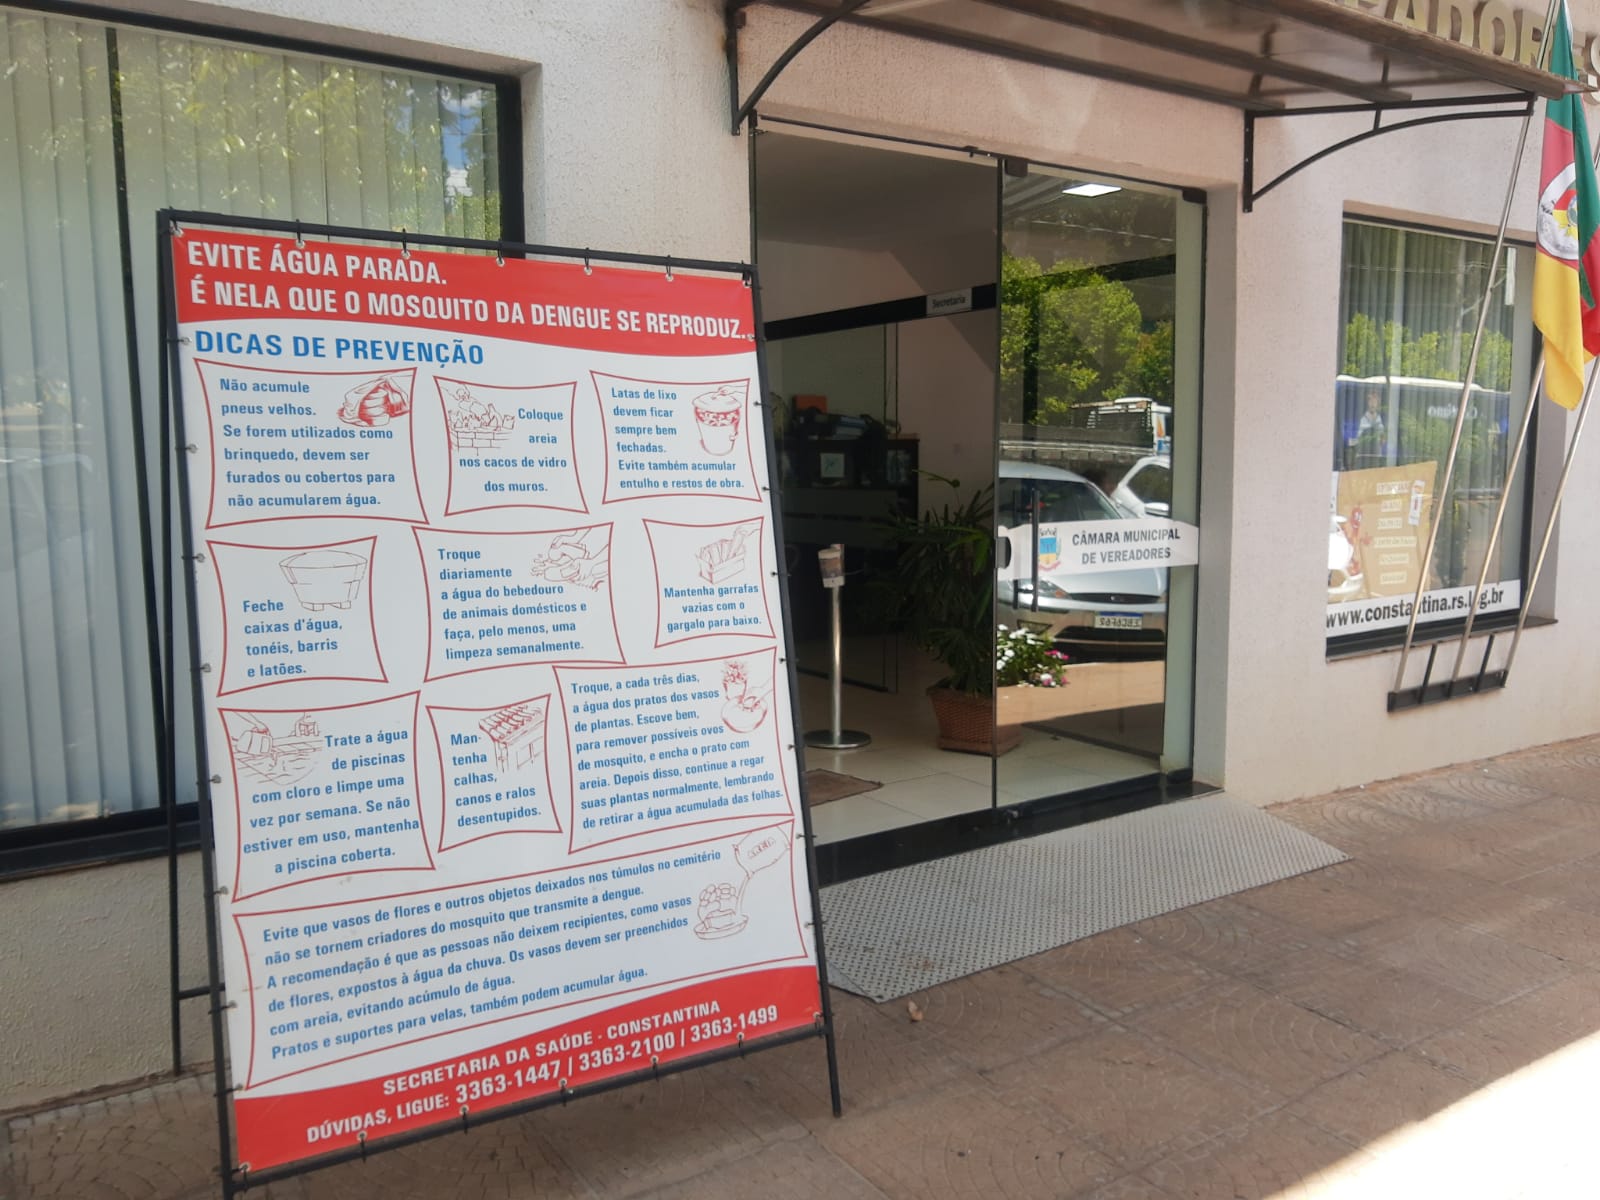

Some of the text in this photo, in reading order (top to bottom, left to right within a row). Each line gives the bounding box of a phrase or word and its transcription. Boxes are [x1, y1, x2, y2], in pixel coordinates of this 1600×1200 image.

[188, 241, 447, 285] EVITE ÁGUA PARADA.
[191, 274, 747, 340] É NELA QUE O MOSQUITO DA DENGUE SE REPRODUZ.
[195, 330, 484, 369] DICAS DE PREVENÇÃO
[220, 378, 310, 394] Não acumule
[611, 387, 677, 401] Latas de lixo
[221, 403, 317, 417] pneus velhos.
[518, 408, 564, 423] Coloque
[613, 405, 674, 418] devem ficar
[223, 424, 394, 439] Se forem utilizados como
[529, 433, 558, 444] areia
[614, 424, 677, 438] sempre bem
[616, 441, 667, 453] fechadas.
[224, 448, 370, 464] brinquedo, devem ser
[459, 456, 567, 468] nos cacos de vidro
[618, 459, 736, 471] Evite também acumular
[226, 471, 396, 486] furados ou cobertos para
[228, 493, 381, 508] não acumularem água.
[1072, 528, 1181, 546] CÂMARA MUNICIPAL
[437, 548, 481, 563] Troque
[1082, 547, 1171, 564] DE VEREADORES
[439, 568, 513, 581] diariamente
[664, 584, 759, 599] Mantenha garrafas
[242, 599, 284, 613] Feche
[682, 602, 745, 614] vazias com o
[244, 618, 343, 635] caixas d'água,
[444, 622, 576, 642] faça, pelo menos, uma
[667, 616, 762, 634] gargalo para baixo.
[245, 638, 339, 656] tonéis, barris
[445, 641, 584, 662] limpeza semanalmente.
[247, 662, 307, 678] e latões.
[571, 672, 700, 695] Troque, a cada três dias,
[574, 710, 700, 734] de plantas. Escove bem,
[324, 730, 409, 748] Trate a água
[450, 733, 481, 747] Man-
[331, 753, 406, 771] de piscinas
[452, 752, 488, 767] tenha
[454, 772, 497, 787] calhas,
[455, 786, 536, 807] canos e ralos
[581, 771, 775, 810] suas plantas normalmente, lembrando
[457, 806, 541, 828] desentupidos.
[243, 818, 420, 854] estiver em uso, mantenha
[275, 847, 396, 875] a piscina coberta.
[265, 886, 644, 966] não se tornem criadores do mosquito que transmite a dengue.
[270, 976, 515, 1036] com areia, evitando acúmulo de água.
[272, 968, 648, 1060] Pratos e suportes para velas, também podem acumular água.
[383, 1054, 500, 1095] SECRETARIA
[505, 1047, 530, 1065] DA
[535, 1031, 593, 1057] SAÚDE
[607, 1001, 721, 1039] CONSTANTINA
[307, 1109, 392, 1143] DÚVIDAS,
[397, 1092, 450, 1121] LIGUE:
[456, 1060, 562, 1105] 3363-1447
[579, 1032, 675, 1071] 3363-2100
[690, 1005, 778, 1043] 3363-1499
